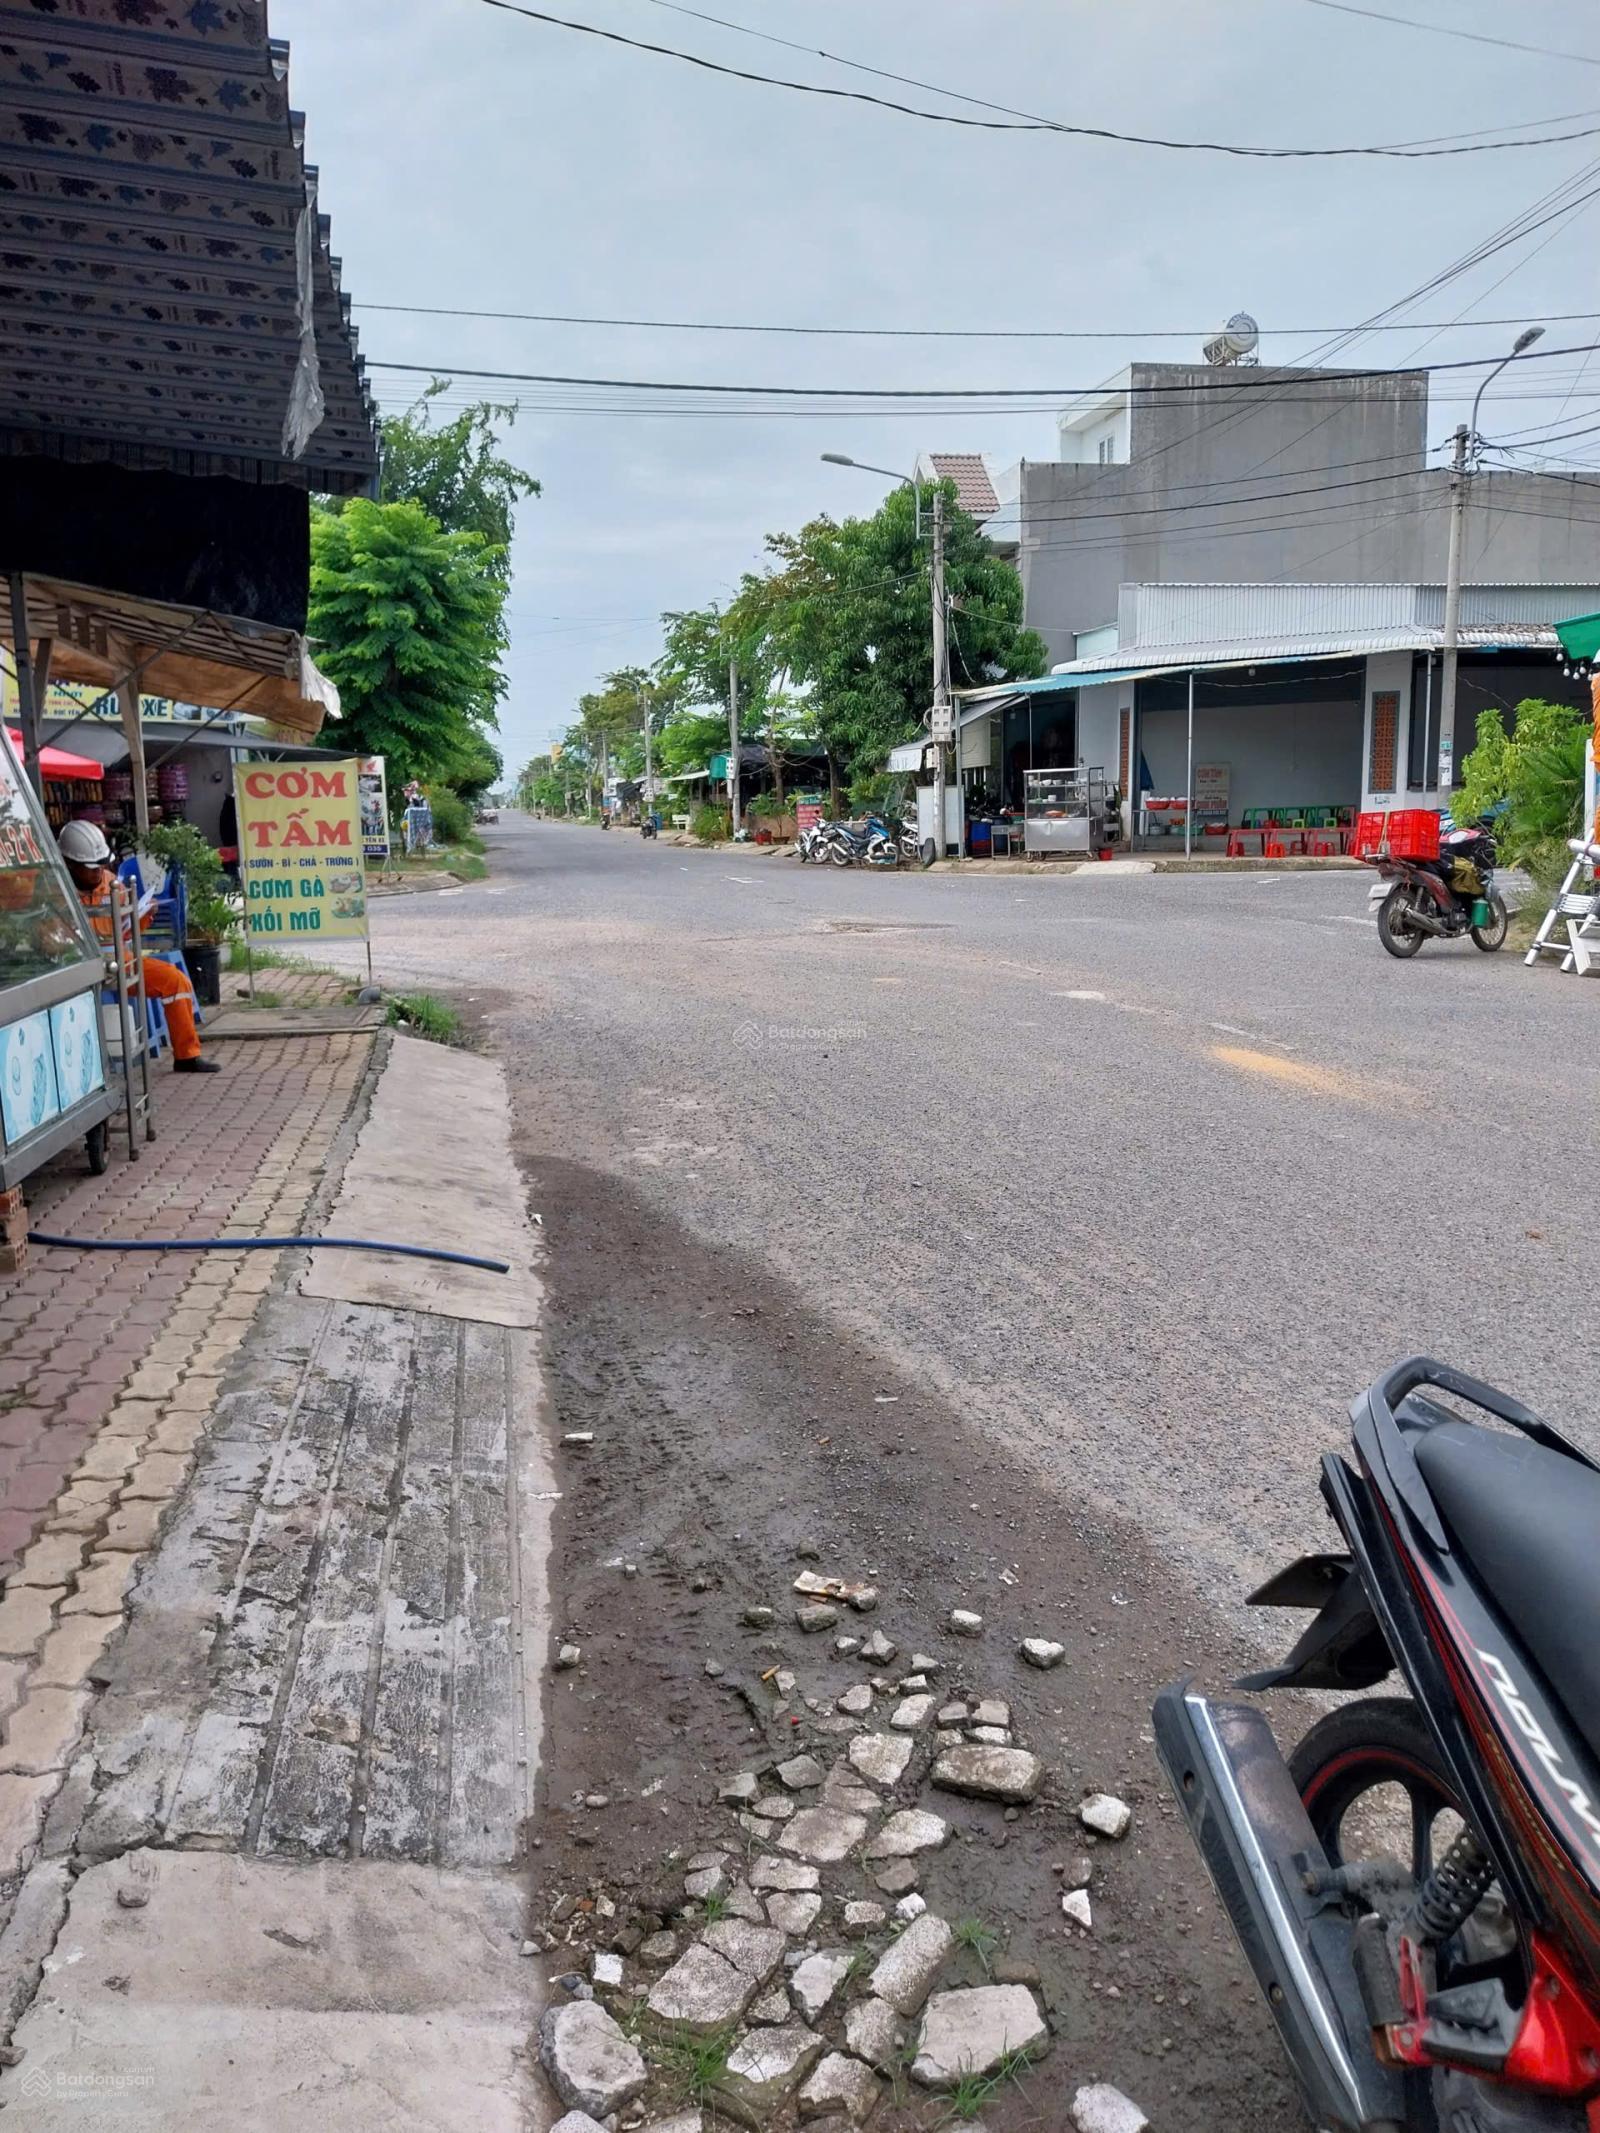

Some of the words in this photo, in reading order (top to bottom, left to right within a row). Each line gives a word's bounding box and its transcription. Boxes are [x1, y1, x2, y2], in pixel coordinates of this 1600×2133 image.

[245, 767, 347, 799] CƠM
[247, 808, 352, 848] TẤM
[249, 878, 293, 899] CƠM
[300, 875, 325, 897] GÀ
[289, 907, 321, 930] MỠ
